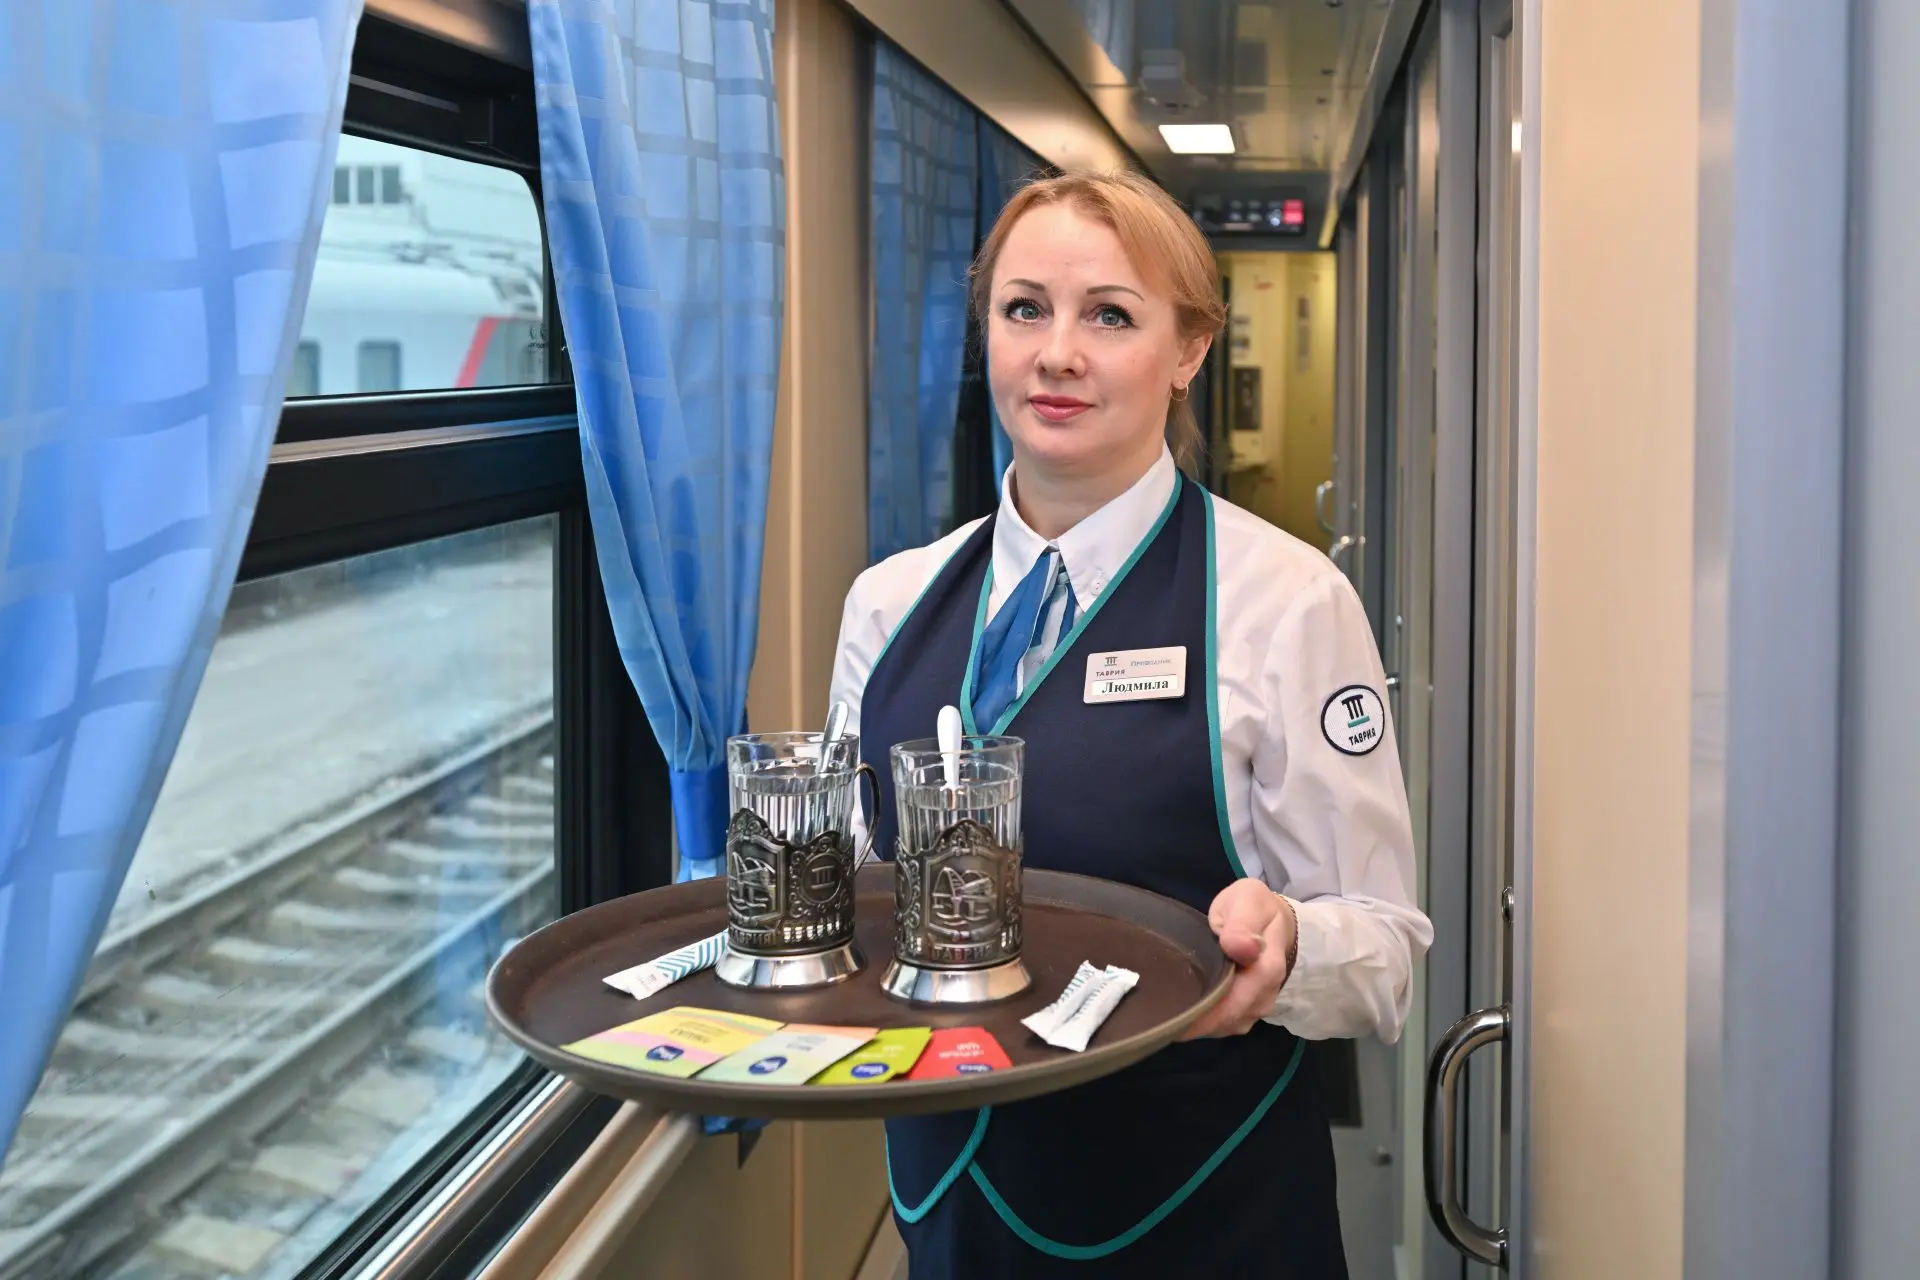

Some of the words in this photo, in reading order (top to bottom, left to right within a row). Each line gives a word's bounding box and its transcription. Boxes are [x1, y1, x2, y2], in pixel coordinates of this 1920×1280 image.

[1096, 669, 1126, 677] ТАВРИЯ
[1102, 680, 1169, 693] Людмила
[1349, 727, 1376, 746] ТАВРИЯ
